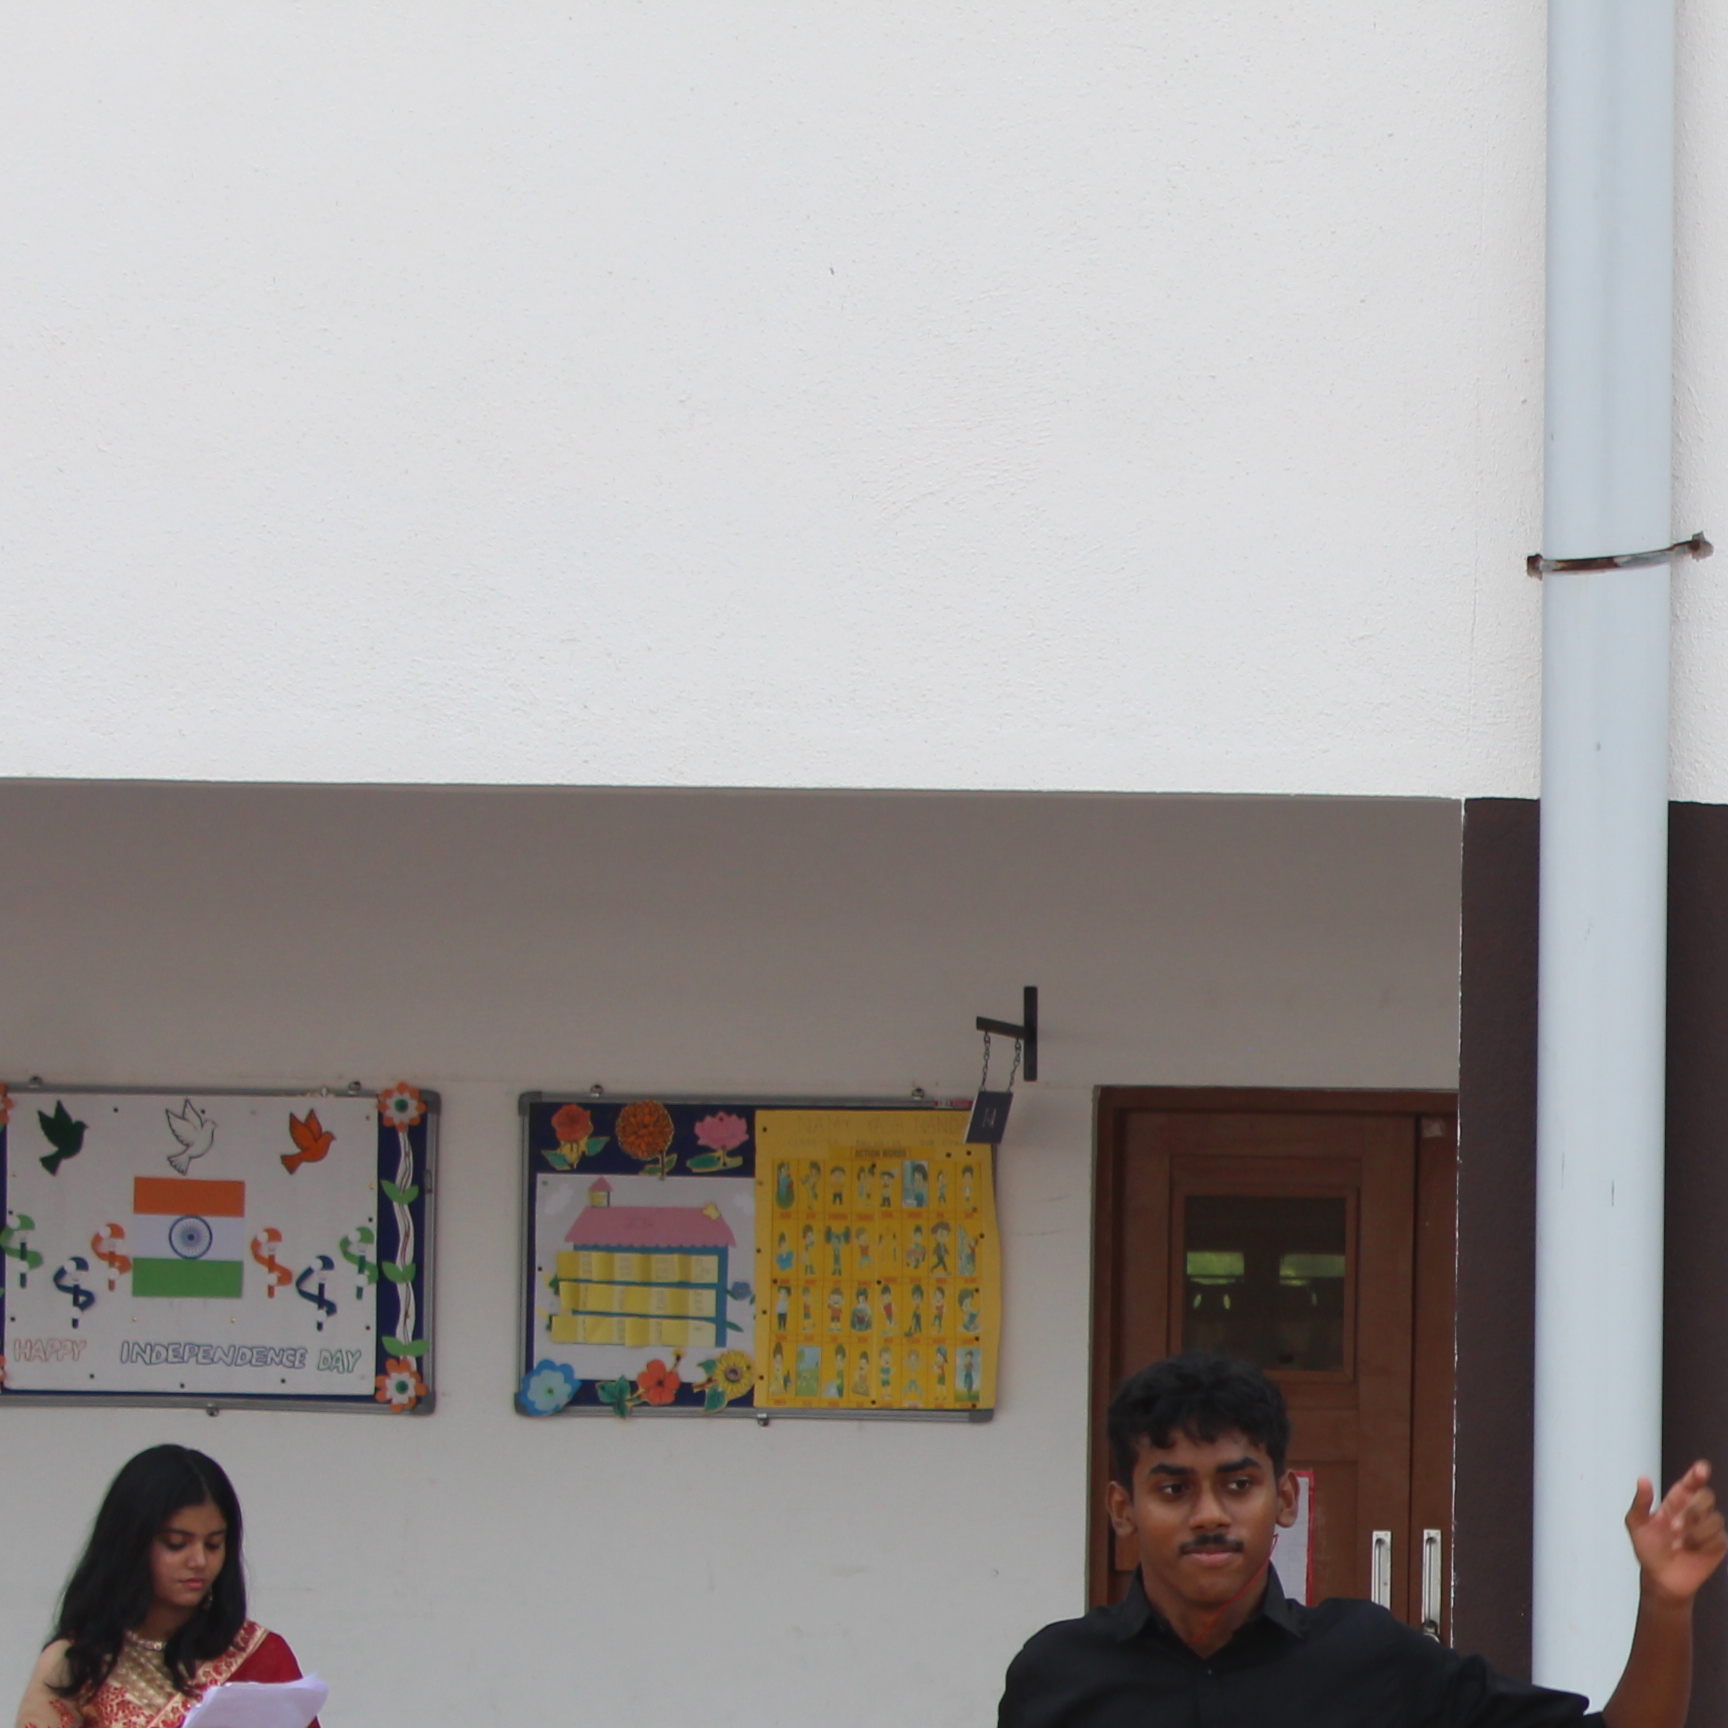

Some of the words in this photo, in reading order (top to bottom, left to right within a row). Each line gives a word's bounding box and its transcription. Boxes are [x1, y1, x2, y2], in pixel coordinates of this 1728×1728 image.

[13, 1338, 87, 1363] HAPPY
[120, 1340, 308, 1370] INDEPENDENCE
[317, 1349, 362, 1374] DAY
